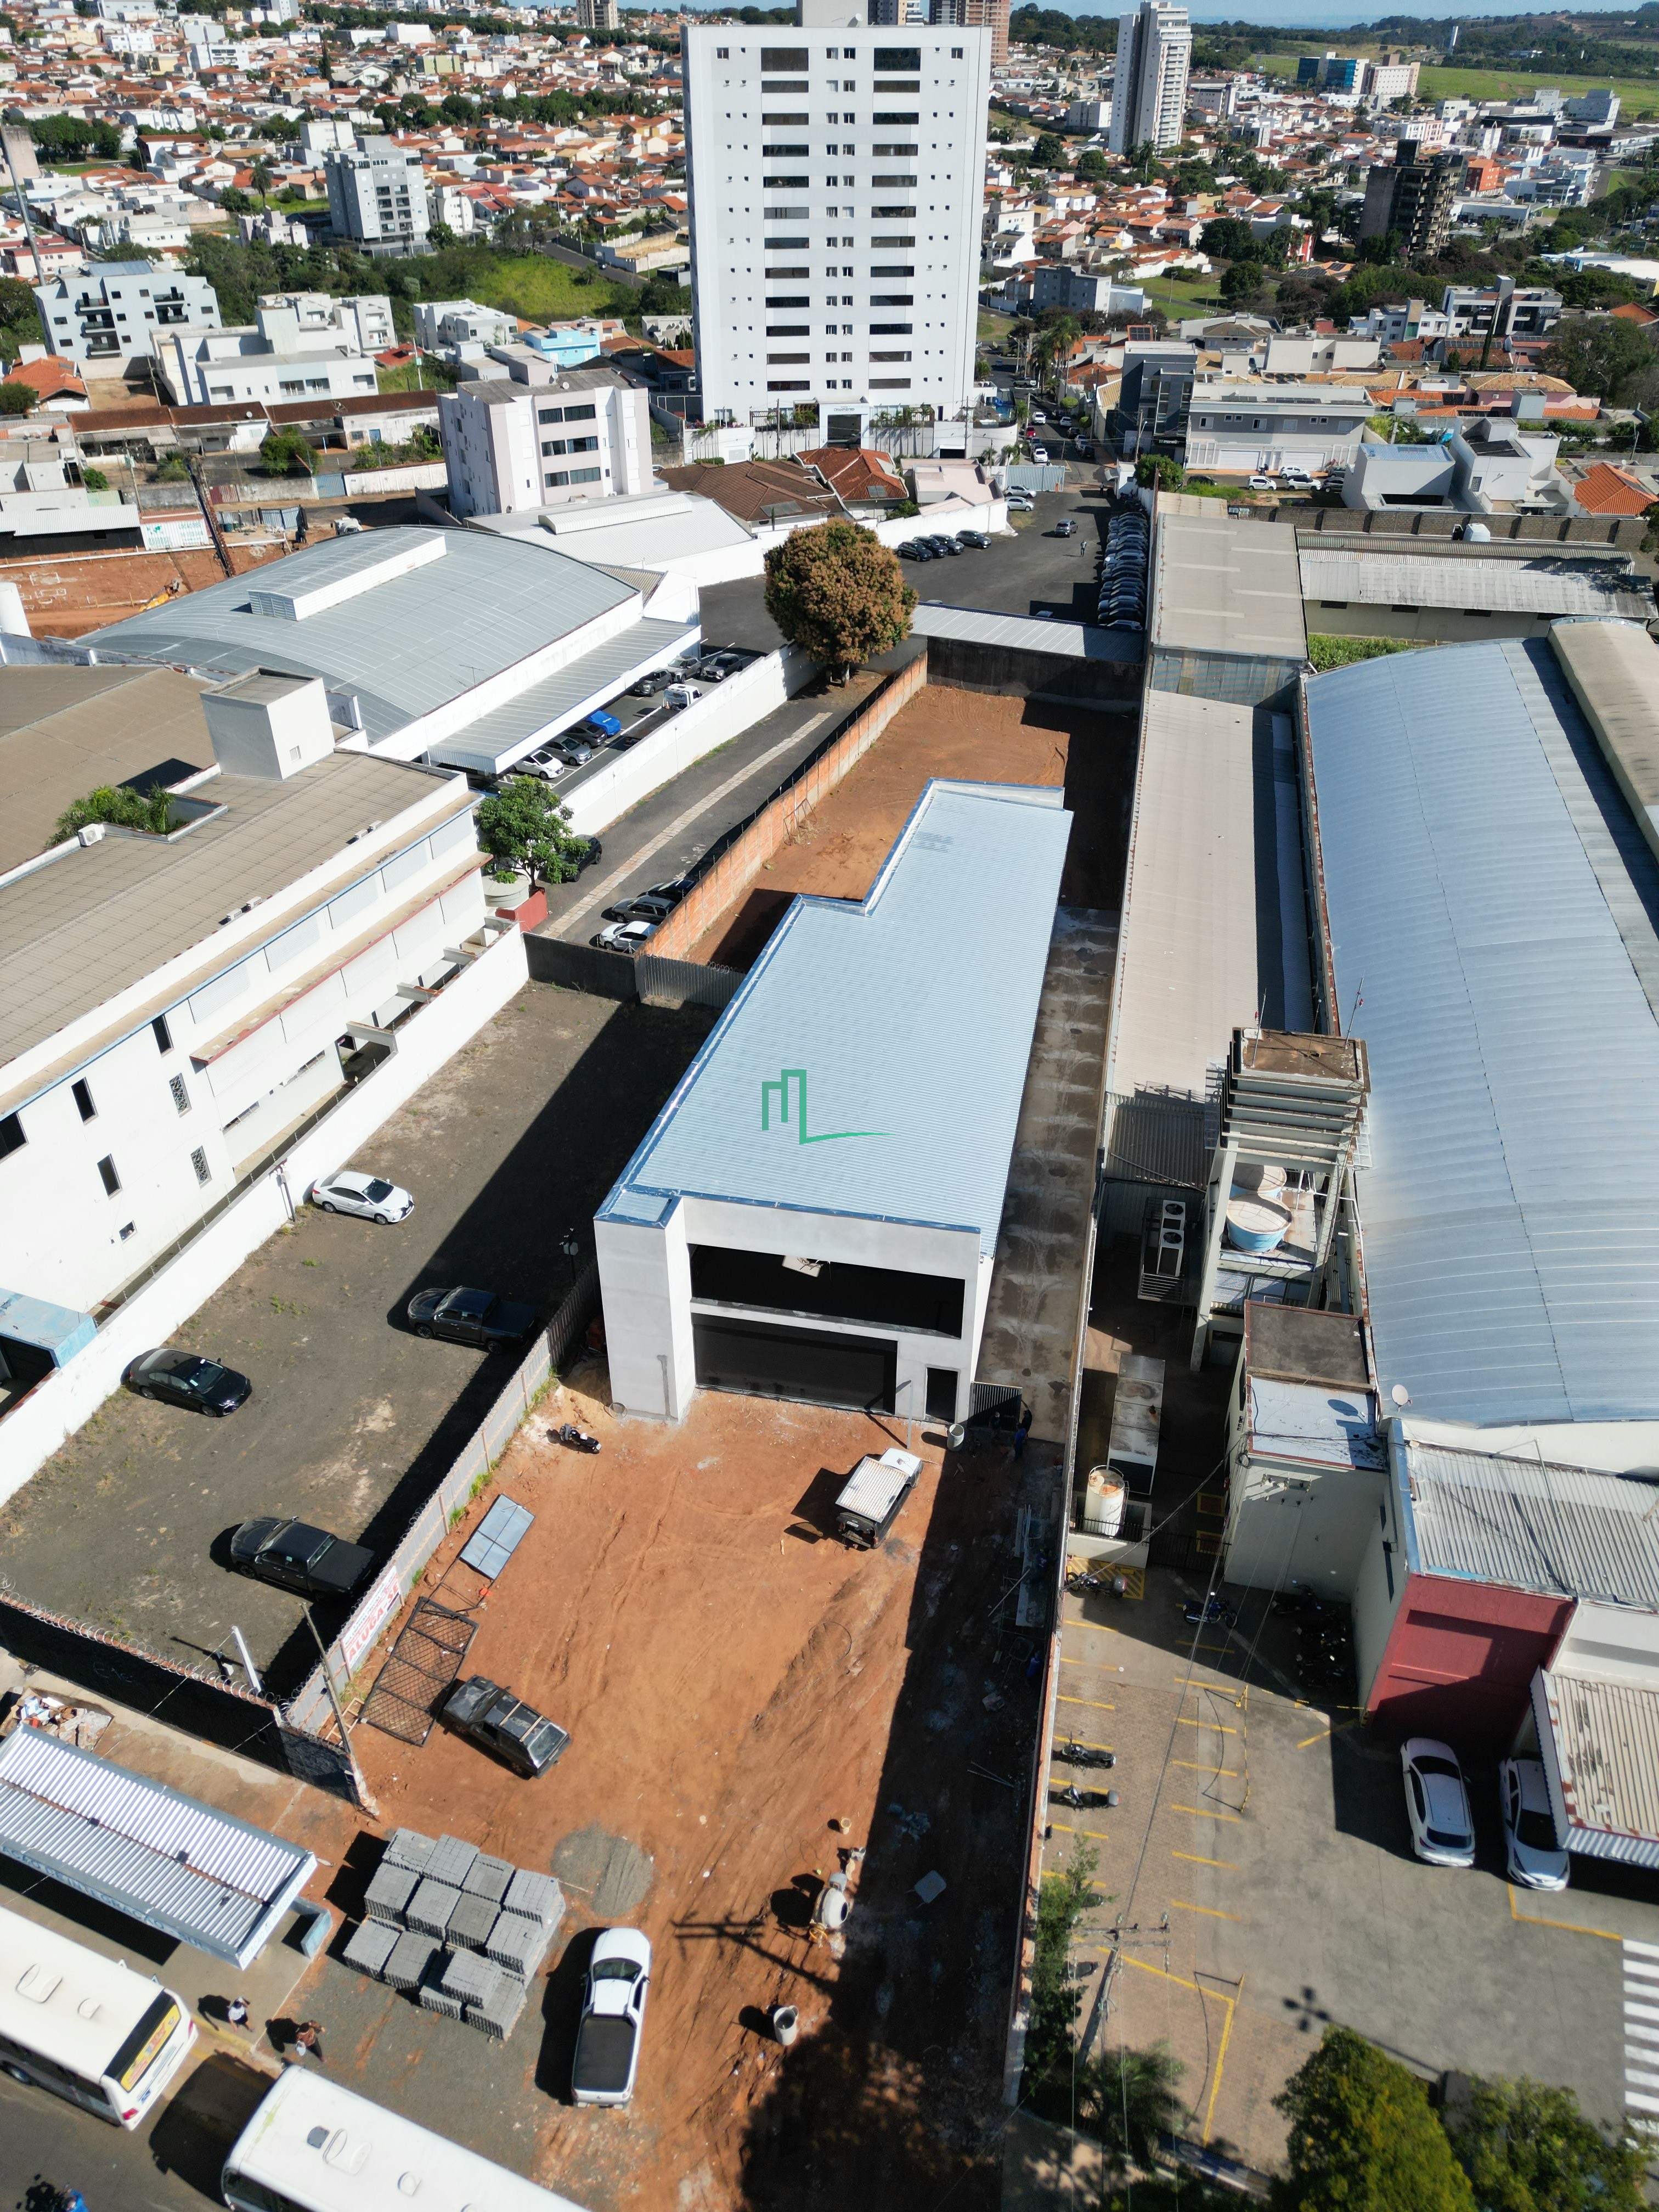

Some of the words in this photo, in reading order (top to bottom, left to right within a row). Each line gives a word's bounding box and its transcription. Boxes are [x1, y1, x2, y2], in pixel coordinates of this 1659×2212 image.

[347, 1581, 399, 1663] ALUGA-SE
[271, 1873, 303, 1923] INTEGRAÇÃO
[304, 1858, 315, 1876] SUL
